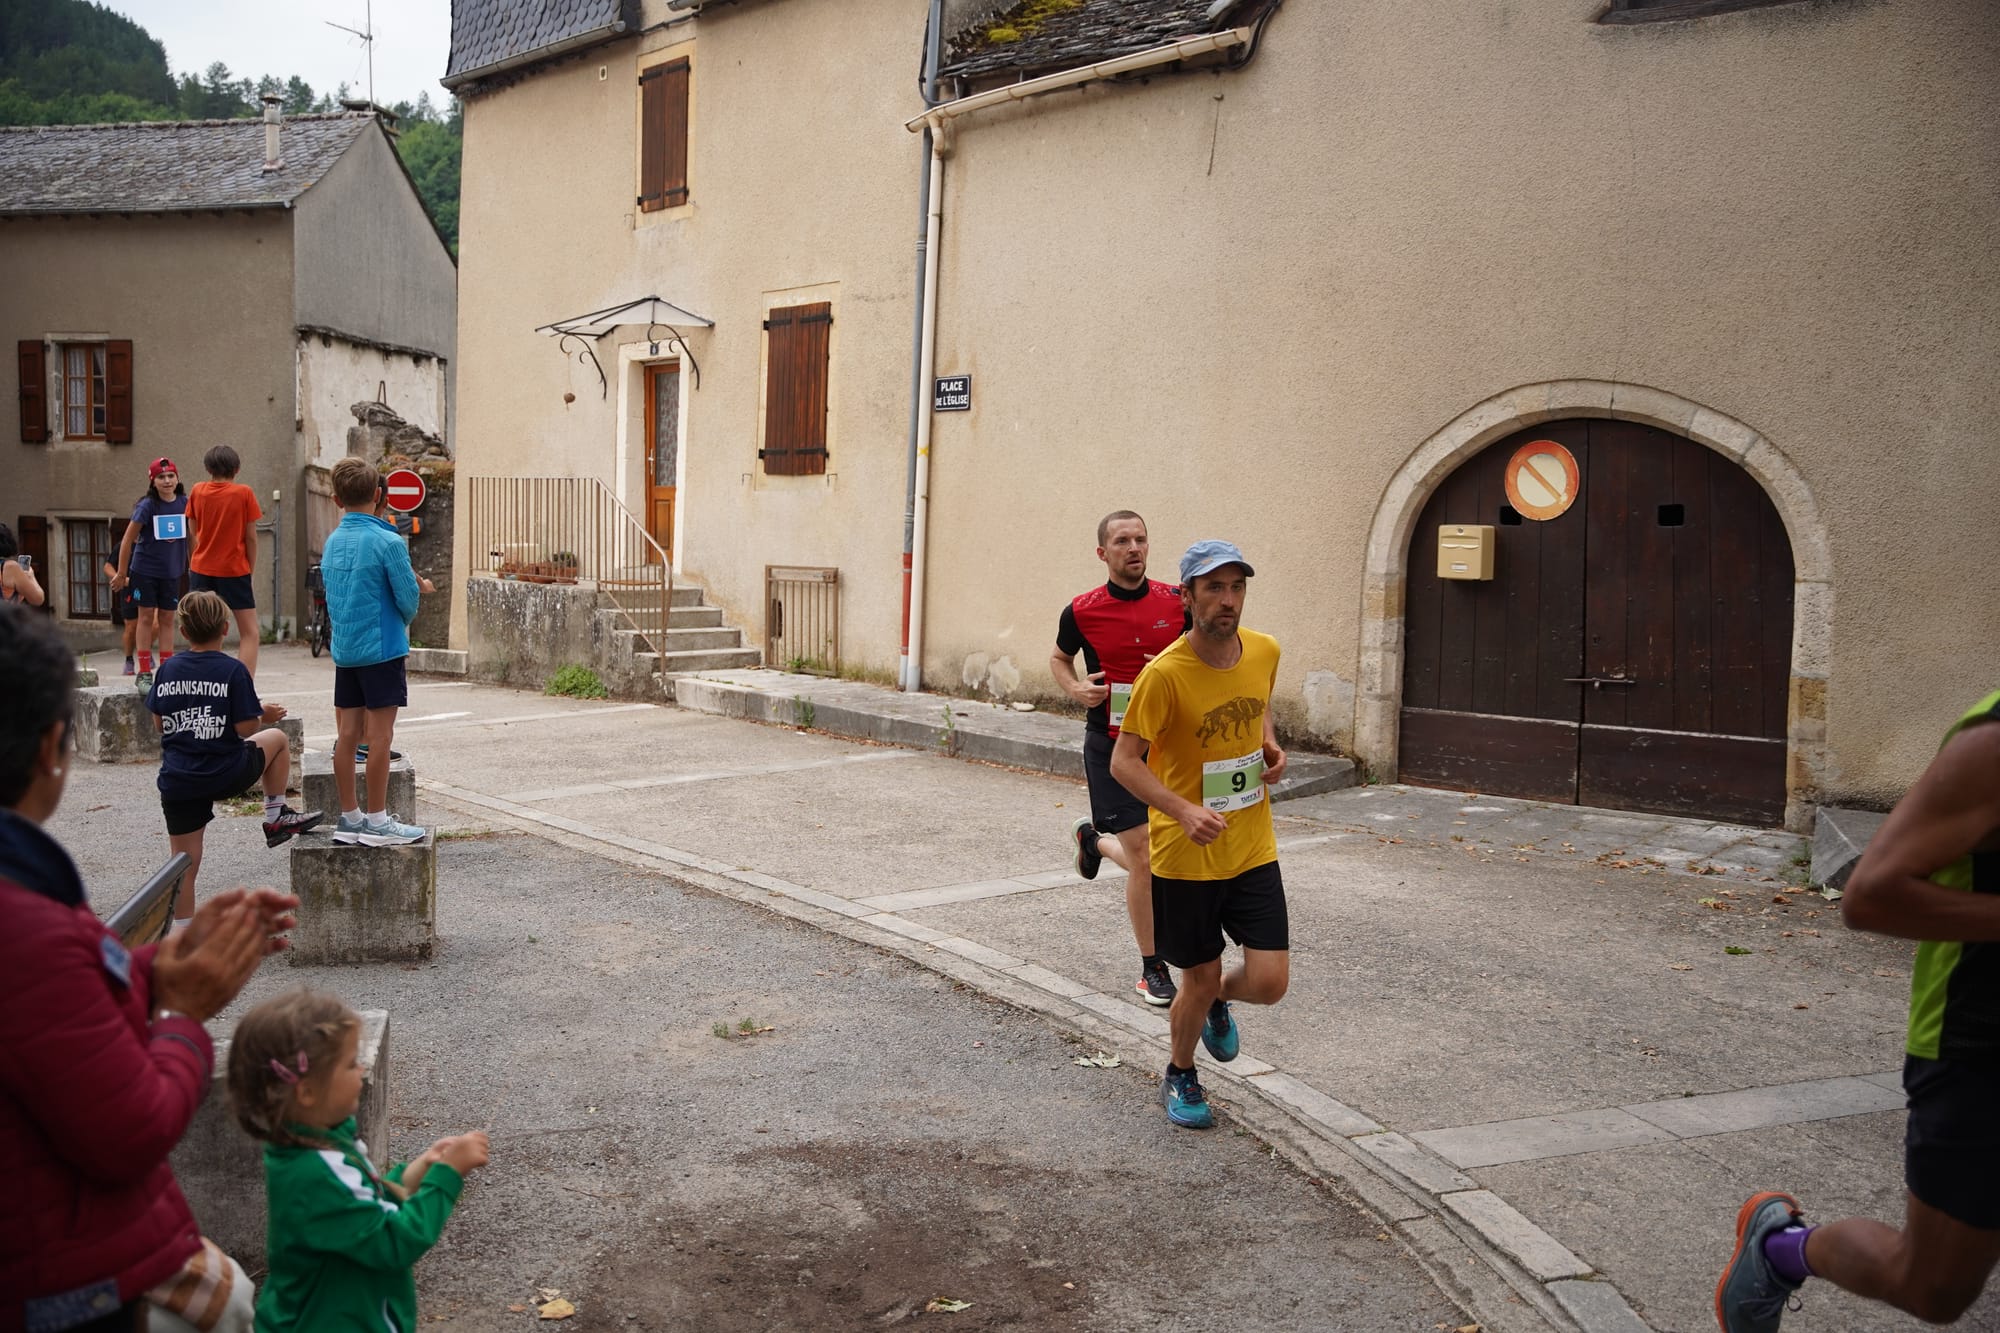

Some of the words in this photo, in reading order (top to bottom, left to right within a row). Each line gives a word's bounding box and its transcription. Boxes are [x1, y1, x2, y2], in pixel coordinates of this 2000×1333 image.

[941, 381, 963, 392] PLACE
[167, 522, 176, 533] 5
[157, 680, 228, 698] ORGANISATION
[1231, 771, 1246, 793] 9
